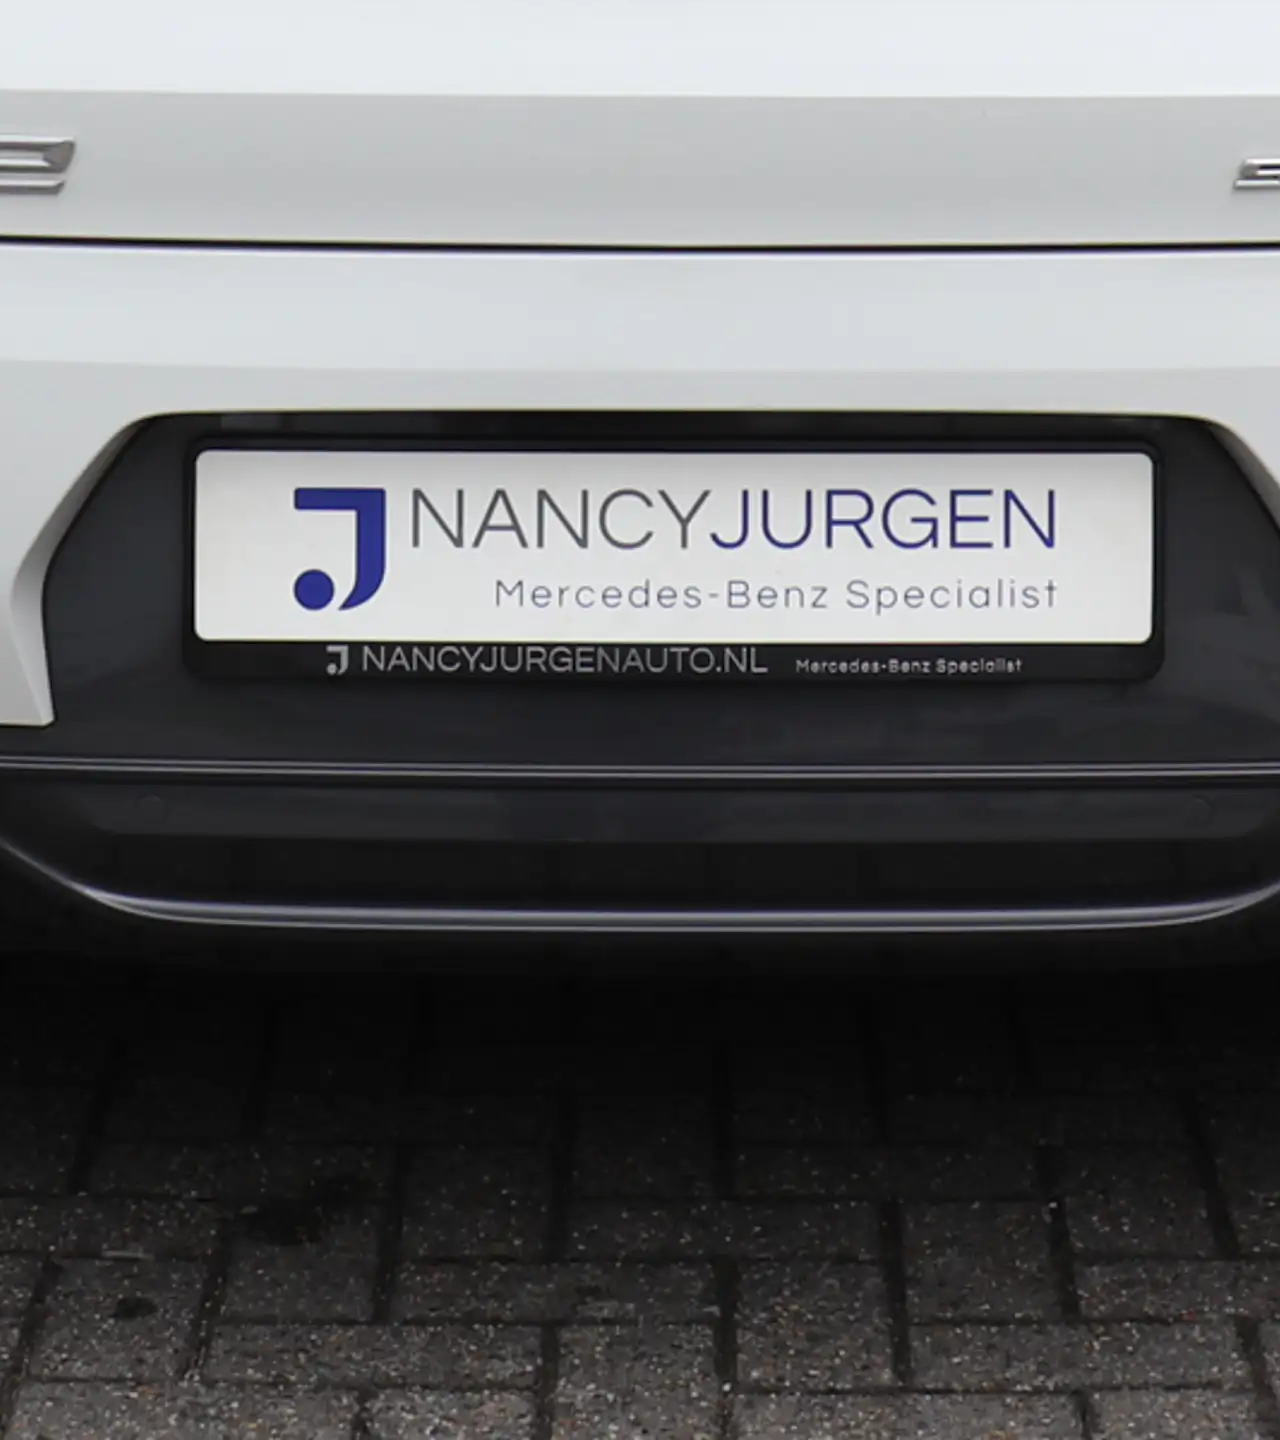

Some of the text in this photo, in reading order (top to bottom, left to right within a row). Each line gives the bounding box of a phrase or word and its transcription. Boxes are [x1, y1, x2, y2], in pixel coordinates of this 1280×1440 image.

[410, 486, 1058, 550] NANCYJURGEN
[494, 577, 1059, 616] Mercedes-Benz Specialist
[360, 645, 769, 674] NANCYJURGENAUTO.NL
[795, 657, 1023, 677] Mercedes-Benz Specialist
